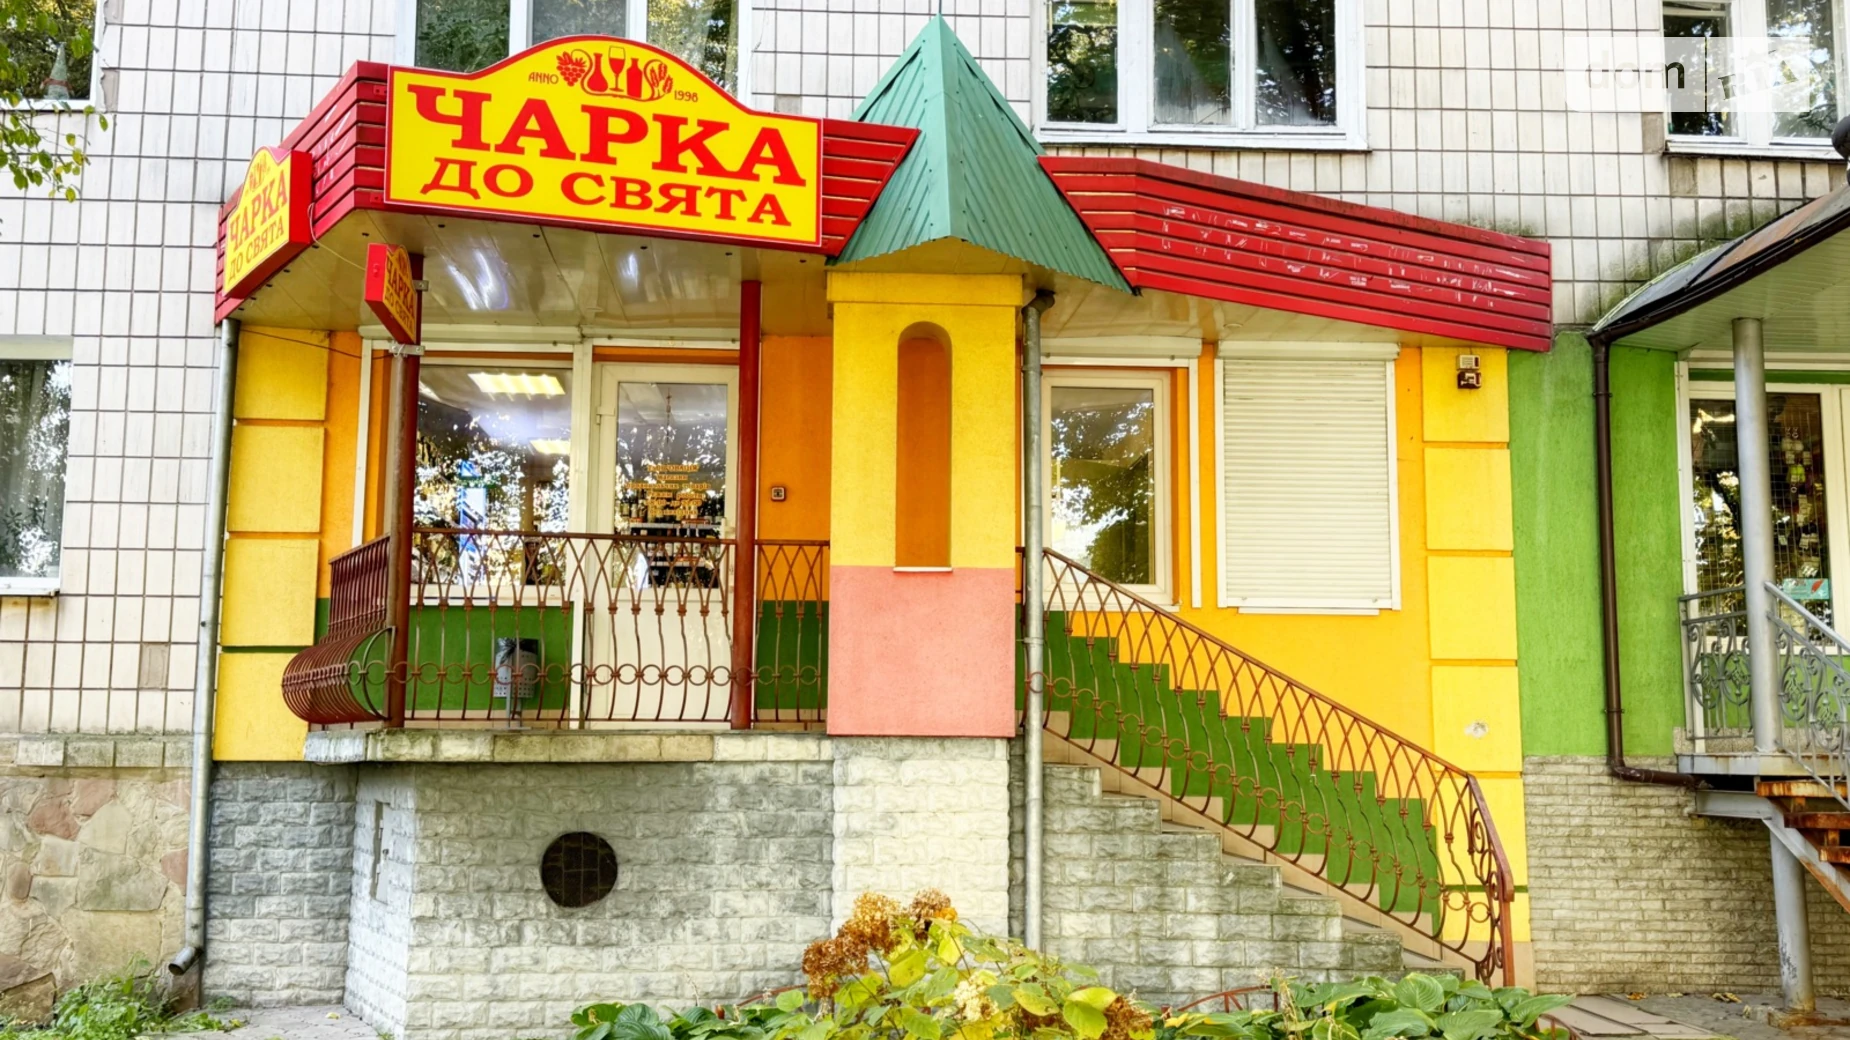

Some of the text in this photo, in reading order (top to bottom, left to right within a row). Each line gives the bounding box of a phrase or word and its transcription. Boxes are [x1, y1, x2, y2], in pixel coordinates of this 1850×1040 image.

[528, 71, 560, 85] ANNO
[673, 90, 699, 103] 1998
[407, 83, 807, 188] ЧАРКА
[230, 168, 288, 253] ЧАРКА
[420, 157, 792, 228] ДО СВЯТА
[228, 215, 285, 284] ДО СВЯТА
